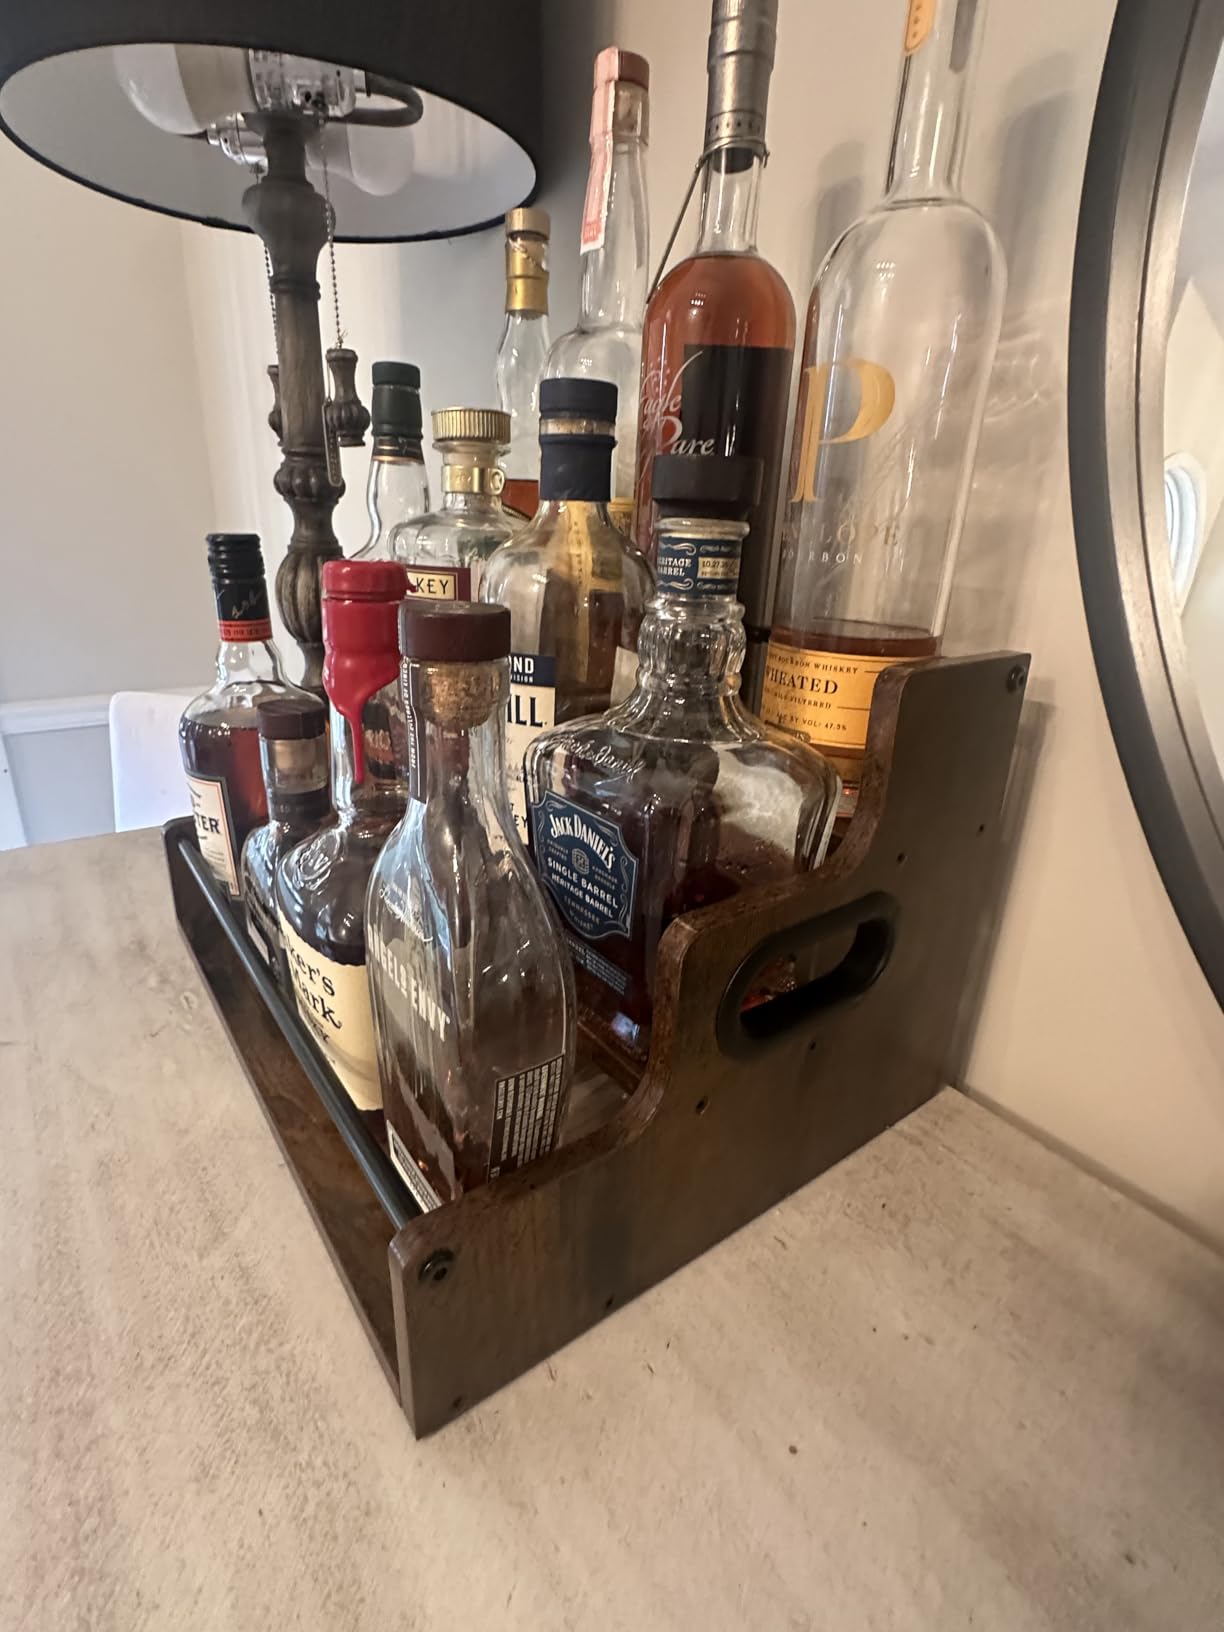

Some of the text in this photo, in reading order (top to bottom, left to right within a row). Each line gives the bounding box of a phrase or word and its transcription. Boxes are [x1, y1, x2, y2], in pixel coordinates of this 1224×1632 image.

[789, 358, 896, 503] P
[415, 577, 449, 595] KEY
[813, 662, 859, 675] WHISKEY
[548, 813, 616, 872] JACK DANIEL'S
[547, 857, 619, 909] SINGLE BARREL
[551, 873, 613, 919] HERITAGE BARREL
